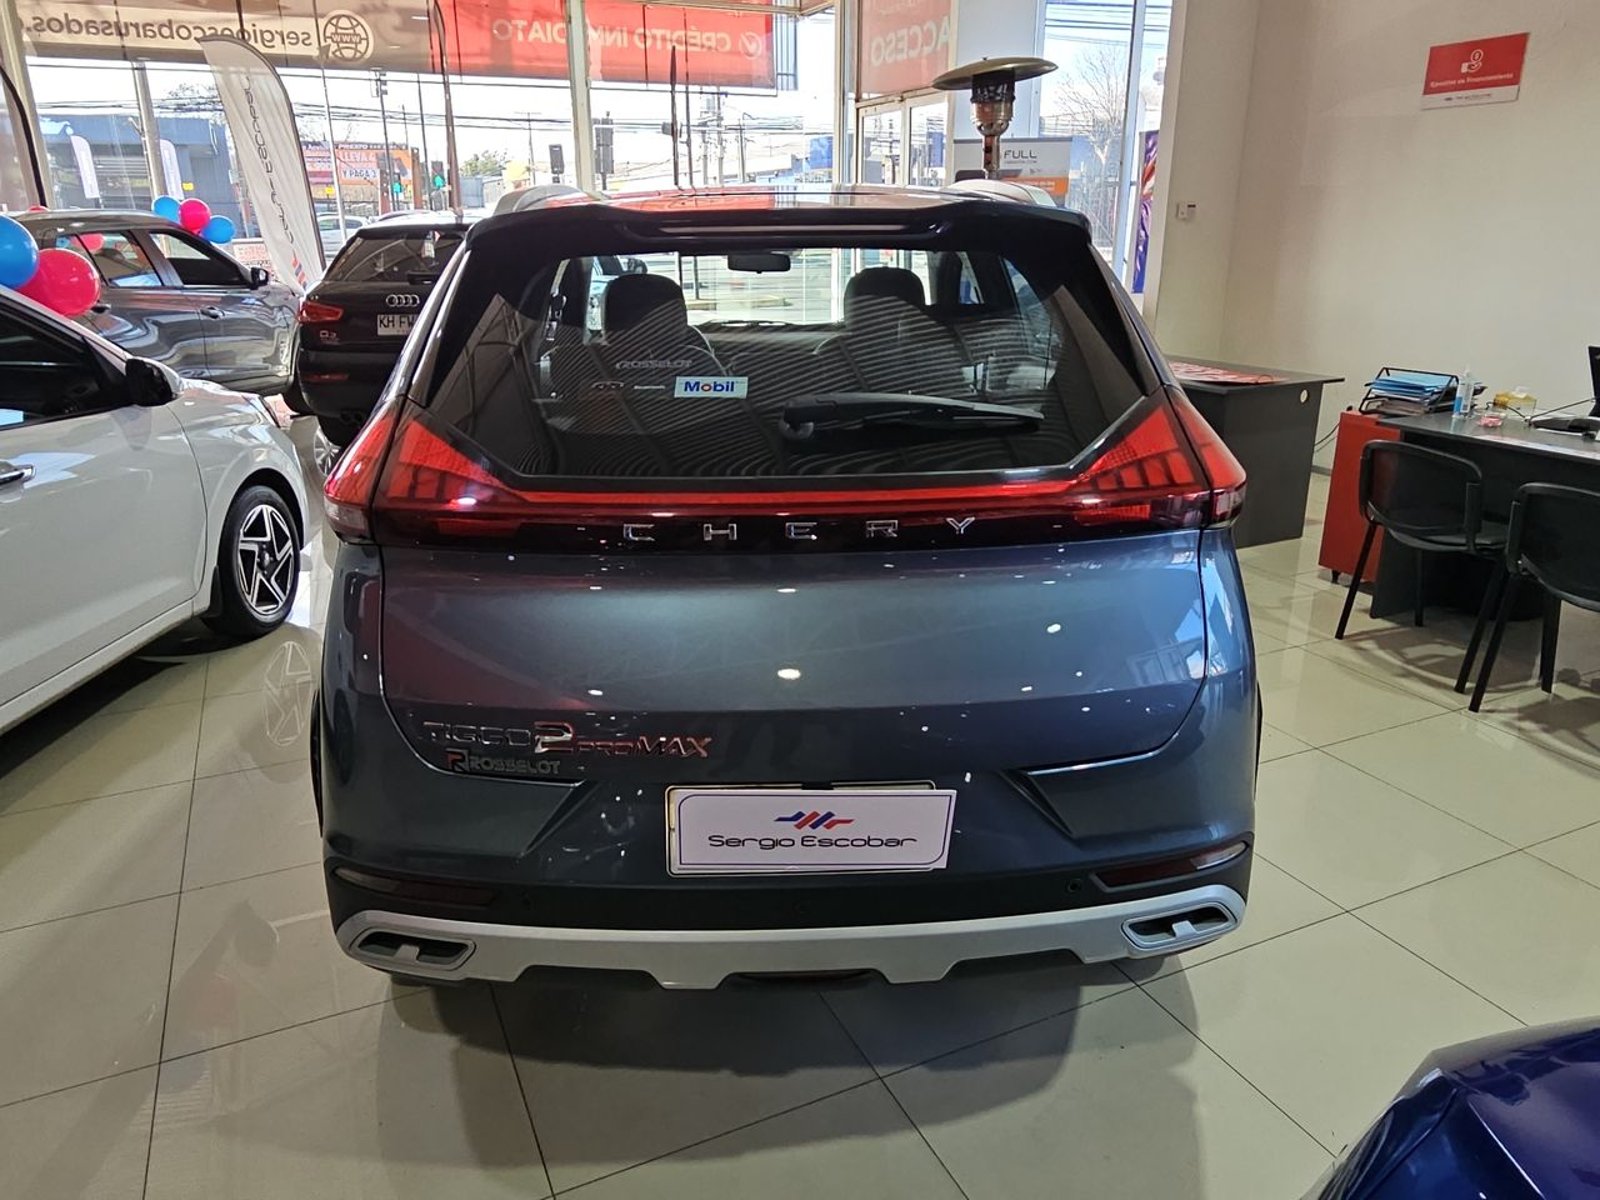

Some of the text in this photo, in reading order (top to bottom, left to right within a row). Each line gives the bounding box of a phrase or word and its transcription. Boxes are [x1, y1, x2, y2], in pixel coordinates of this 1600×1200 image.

[1003, 149, 1038, 160] FULL
[349, 169, 371, 178] PAGA
[379, 314, 395, 329] KH
[684, 380, 735, 393] Mobil
[622, 516, 976, 542] CHERY
[469, 755, 561, 775] ROSSELOT
[707, 834, 918, 851] Sergio Escobar
